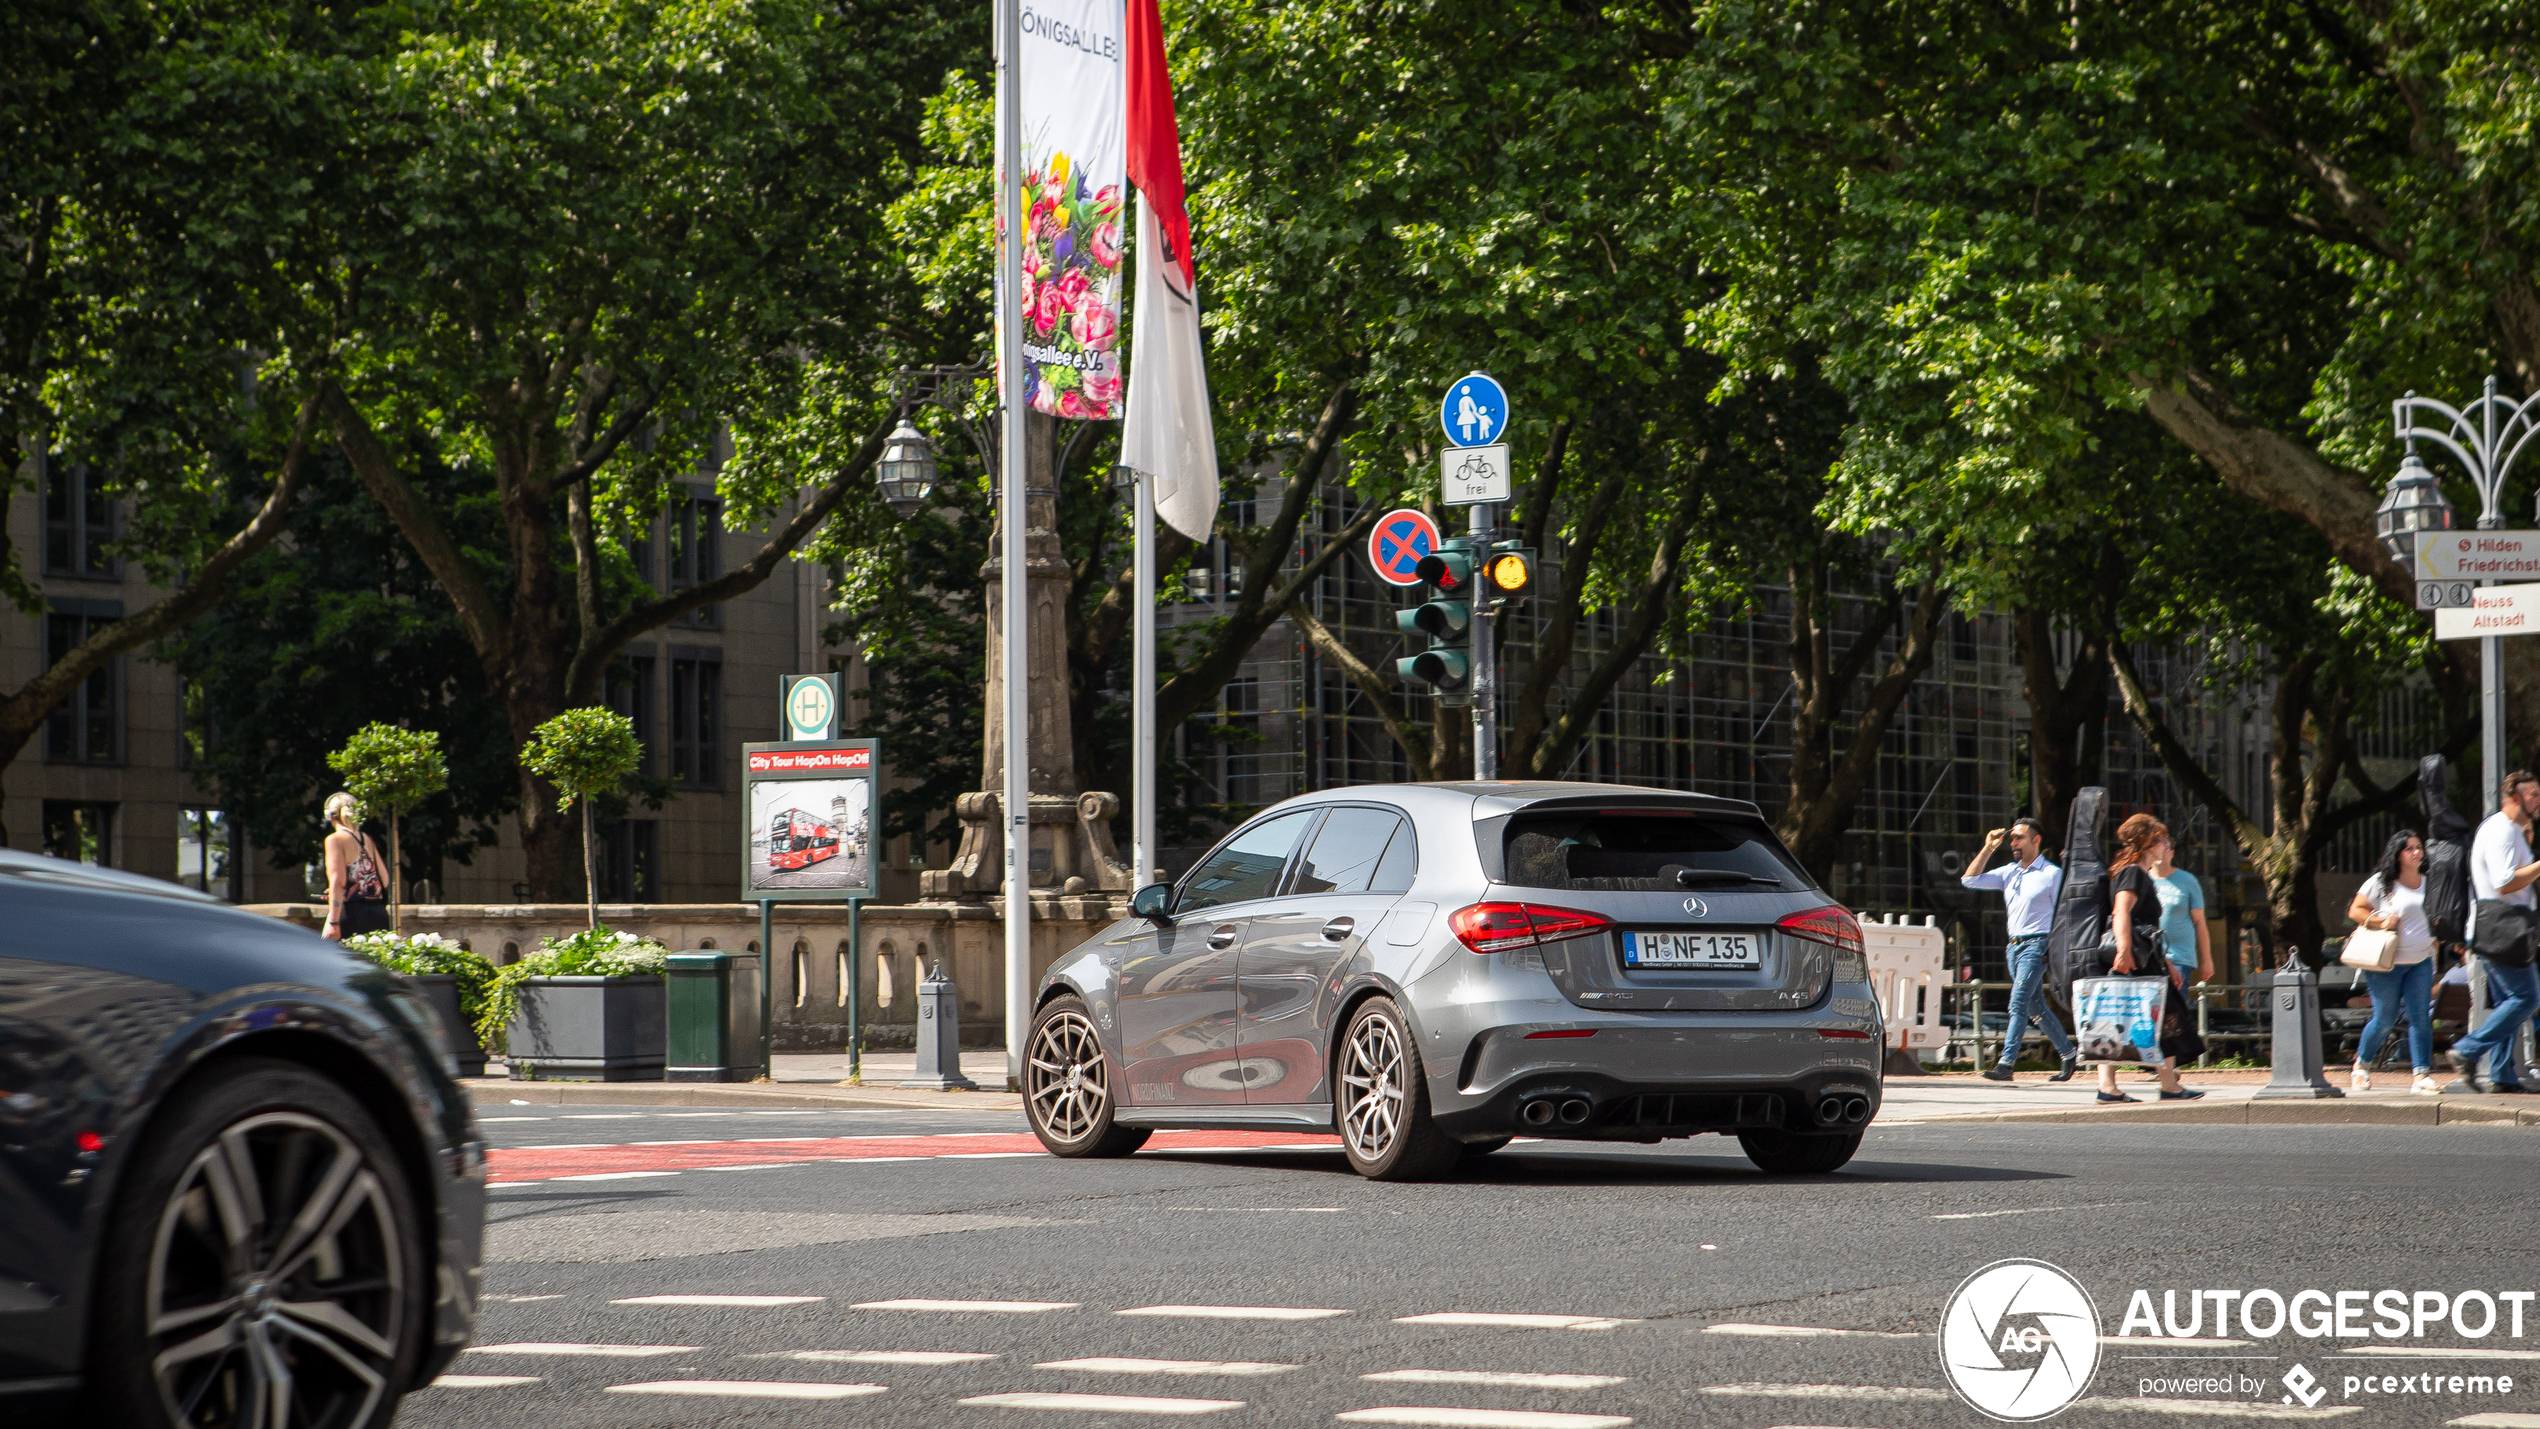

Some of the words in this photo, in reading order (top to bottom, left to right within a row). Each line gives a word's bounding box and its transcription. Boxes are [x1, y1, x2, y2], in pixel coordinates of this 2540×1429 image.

[1020, 5, 1118, 62] ÖNIGSALLE
[1022, 340, 1072, 367] nigsallee
[1072, 350, 1103, 370] e.V.
[1466, 483, 1486, 495] frei
[2477, 538, 2522, 552] Hilden
[2458, 558, 2540, 572] Friedrichst
[2473, 596, 2513, 609] Neuss
[2473, 612, 2525, 628] Altstadt
[802, 691, 819, 722] H
[749, 756, 770, 769] City
[771, 756, 794, 767] Tour
[795, 754, 831, 768] HopOn
[832, 752, 869, 767] HopOff
[1644, 935, 1659, 958] H
[1673, 935, 1701, 959] NF
[1707, 936, 1748, 960] 135
[1778, 991, 1788, 1000] A
[1791, 991, 1809, 1000] 45
